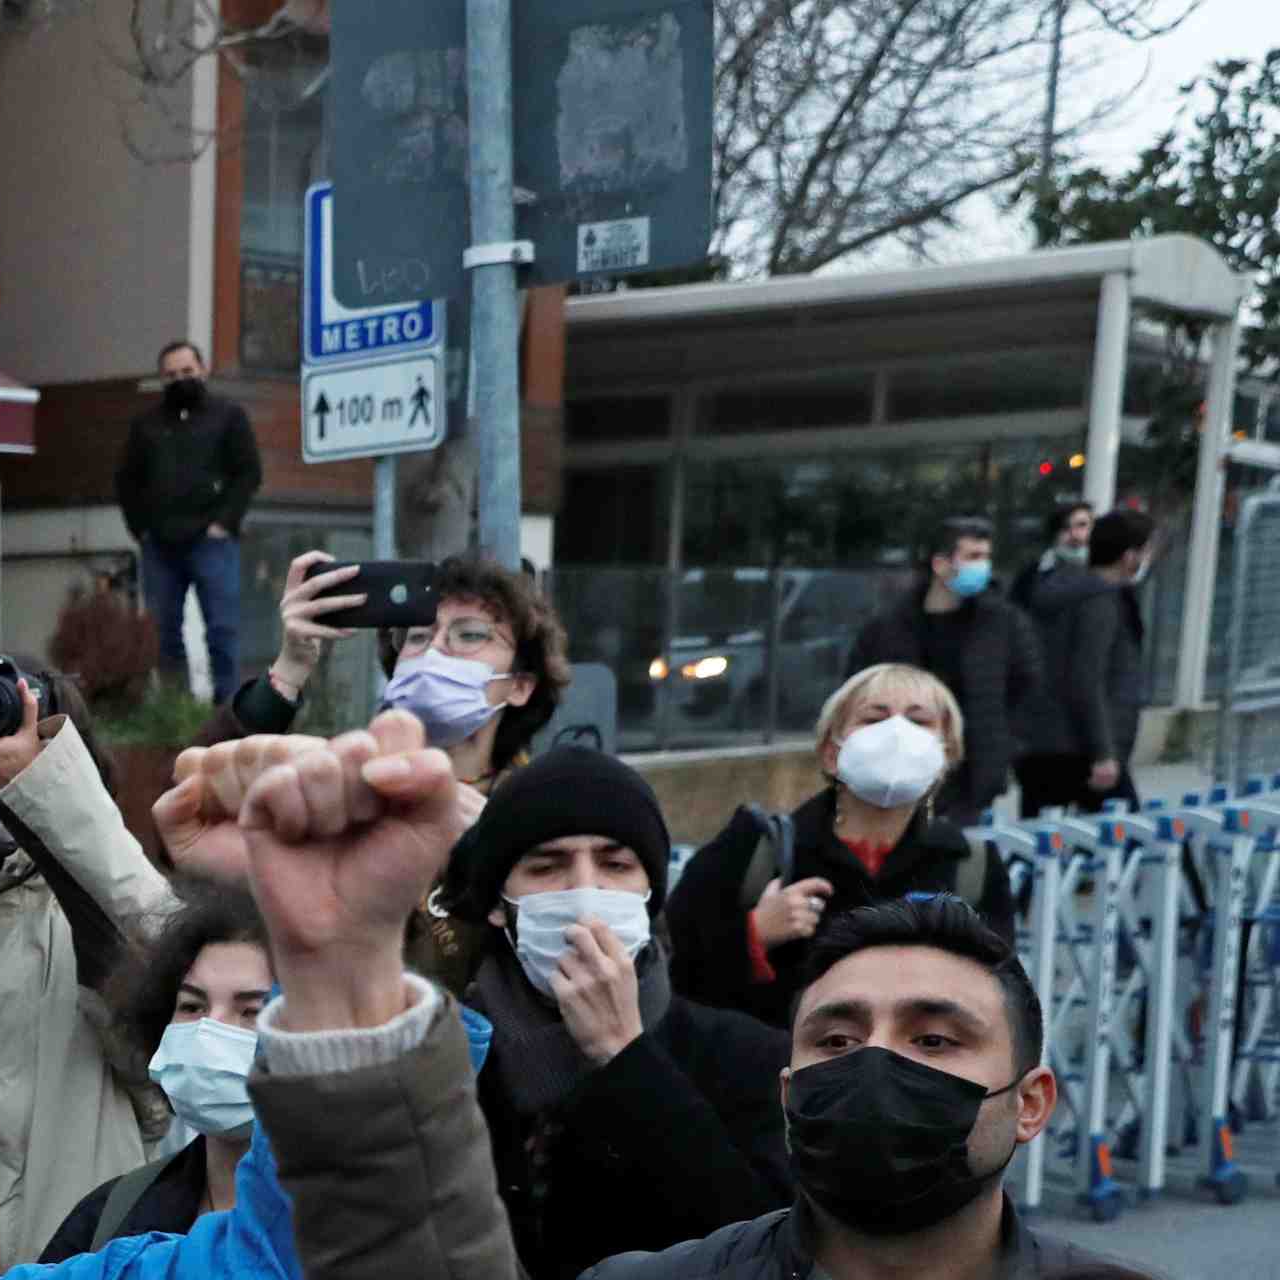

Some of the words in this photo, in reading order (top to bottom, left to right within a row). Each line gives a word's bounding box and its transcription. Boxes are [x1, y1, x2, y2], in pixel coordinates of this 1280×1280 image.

[321, 312, 423, 355] METRO
[336, 394, 375, 426] 100
[382, 397, 404, 421] m
